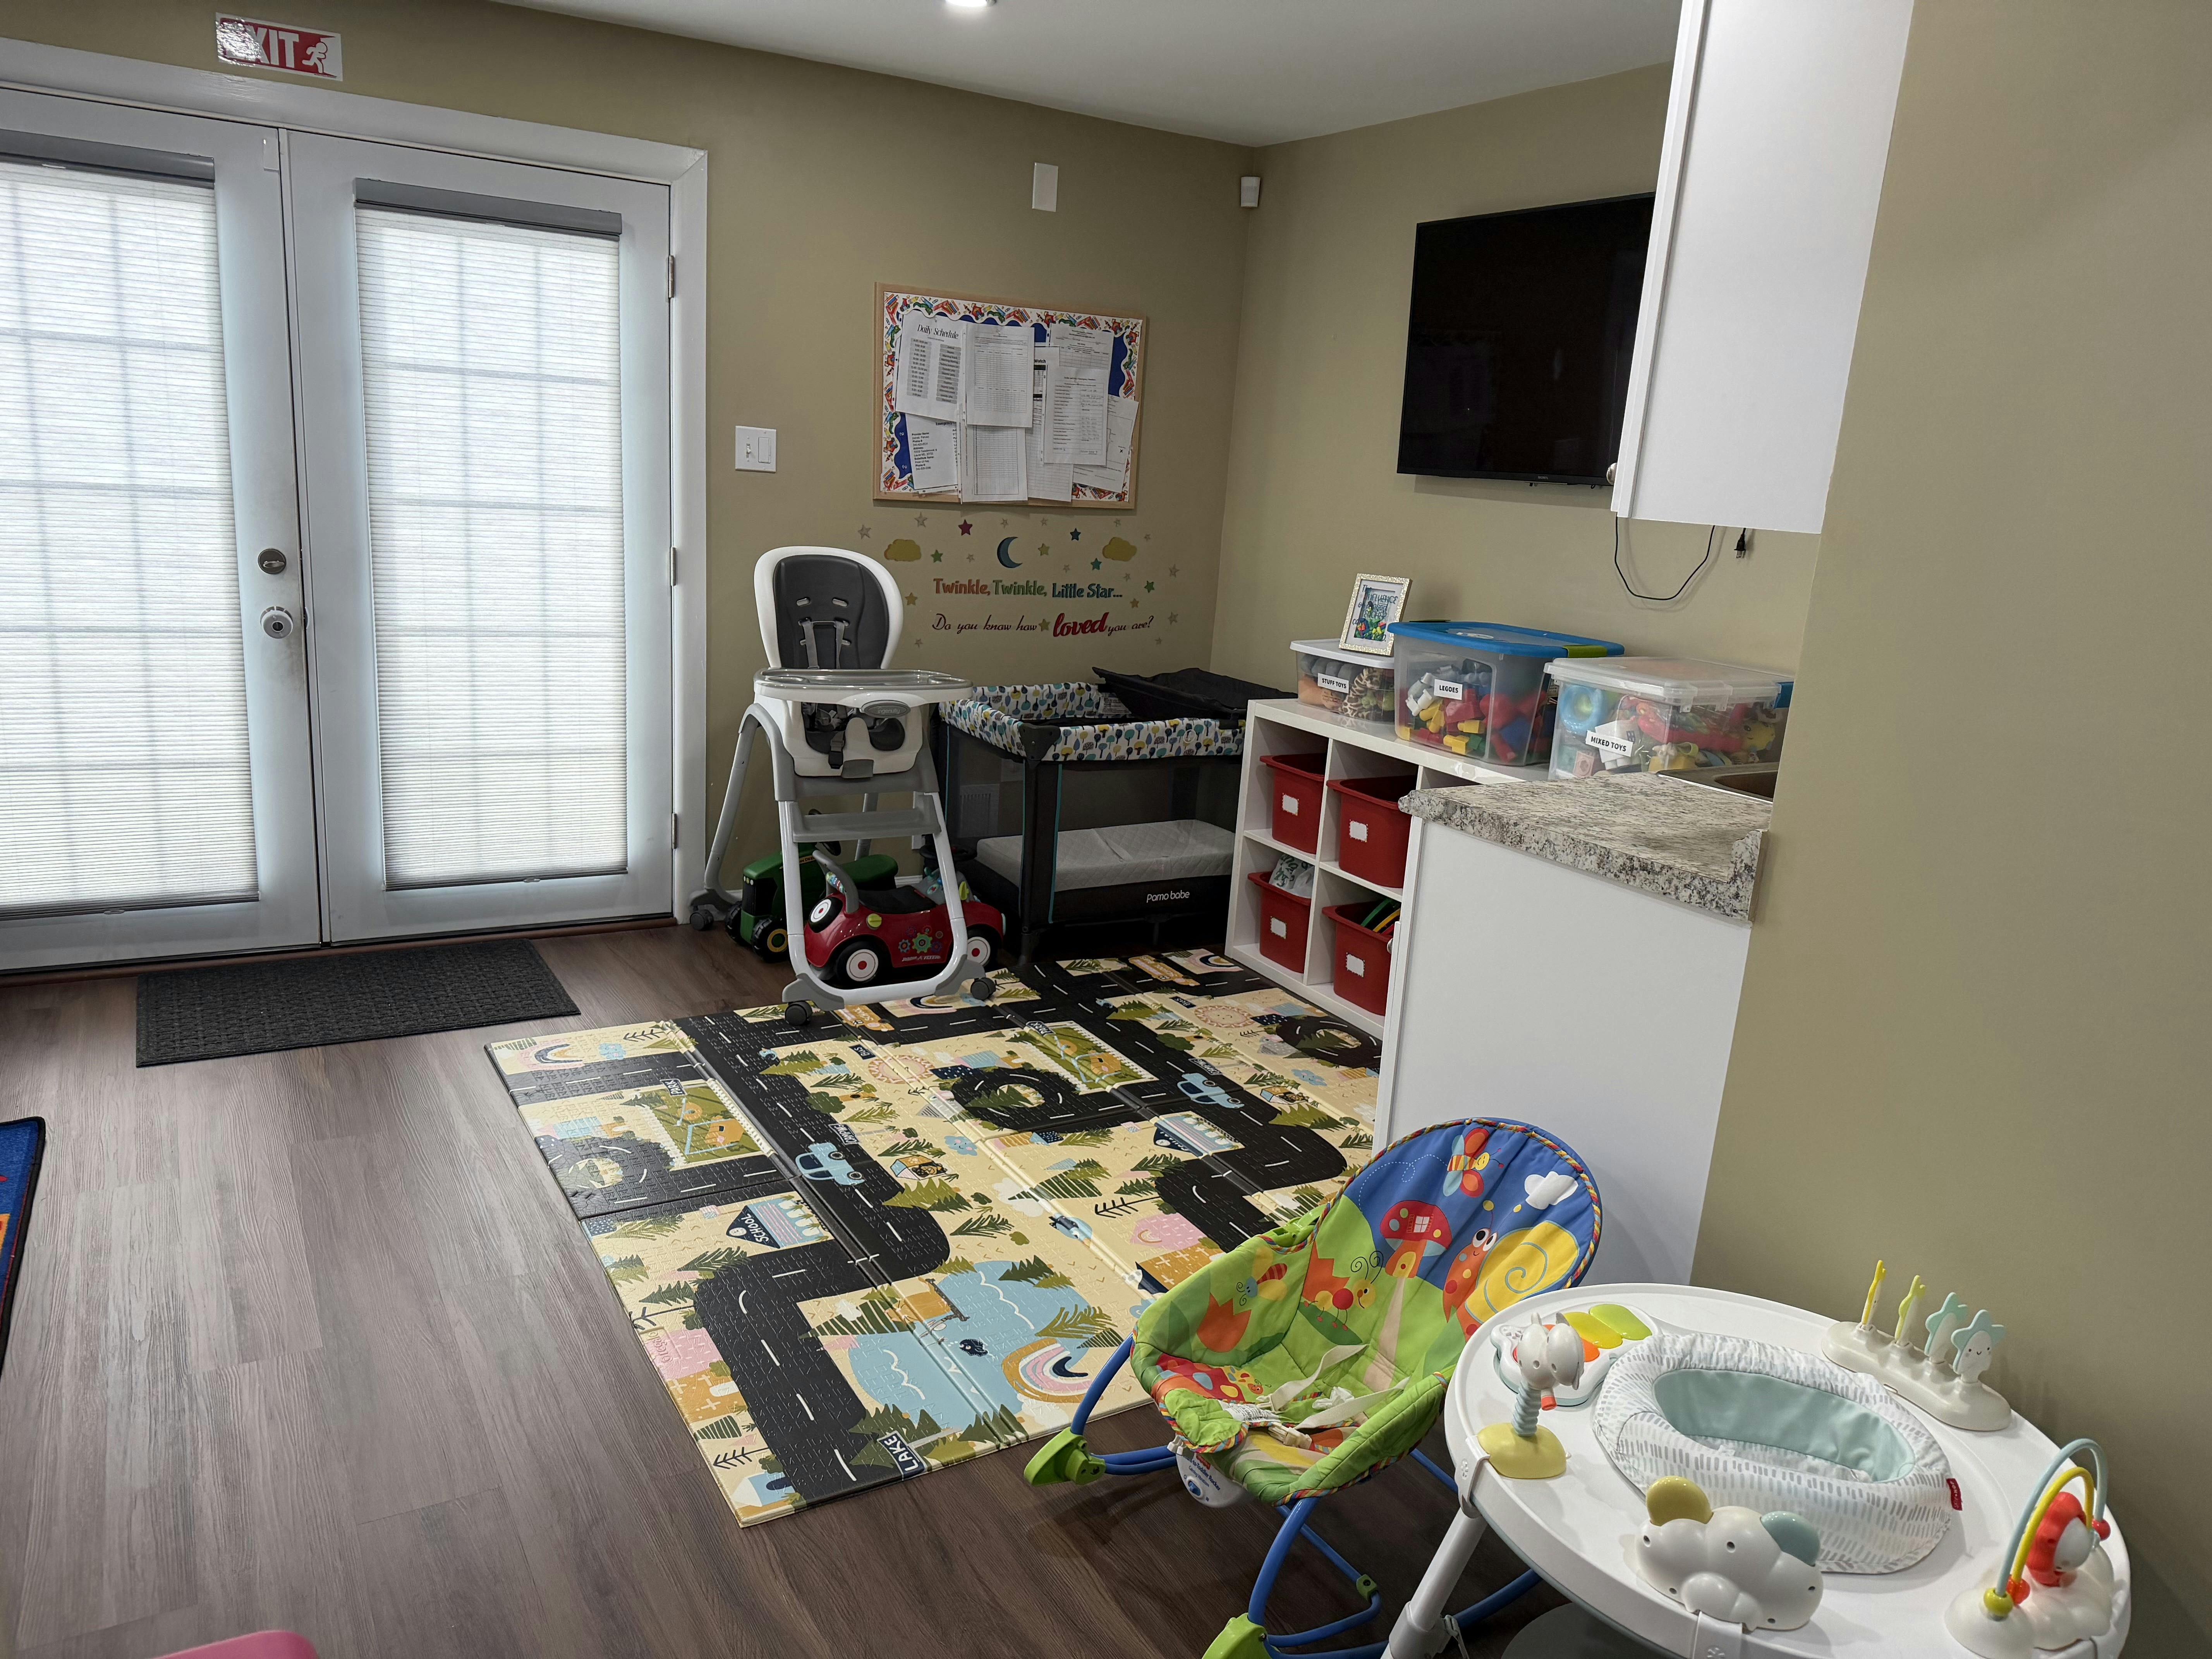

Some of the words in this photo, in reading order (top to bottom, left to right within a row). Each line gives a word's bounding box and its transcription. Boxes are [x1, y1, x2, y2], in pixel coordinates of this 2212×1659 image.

[224, 22, 299, 68] XIT
[917, 325, 932, 335] Daily
[934, 328, 958, 339] Schedule
[933, 579, 991, 596] Twinkle,
[993, 580, 1048, 597] Twinkle,
[1052, 583, 1084, 599] Little
[932, 613, 951, 630] Do
[957, 623, 977, 634] you
[984, 614, 1011, 631] know
[1016, 615, 1037, 632] how
[1053, 612, 1109, 637] loved
[1108, 624, 1127, 635] you
[1131, 615, 1154, 630] are?
[1439, 685, 1459, 693] LEGOES
[1590, 736, 1610, 747] MIXED
[1611, 742, 1627, 752] TOYS
[1170, 890, 1190, 900] babe
[1030, 1022, 1051, 1034] PARK
[854, 1046, 870, 1057] BUS
[665, 1080, 683, 1094] PARK
[741, 1213, 769, 1242] SCHOOL
[884, 1435, 919, 1471] LAKE
